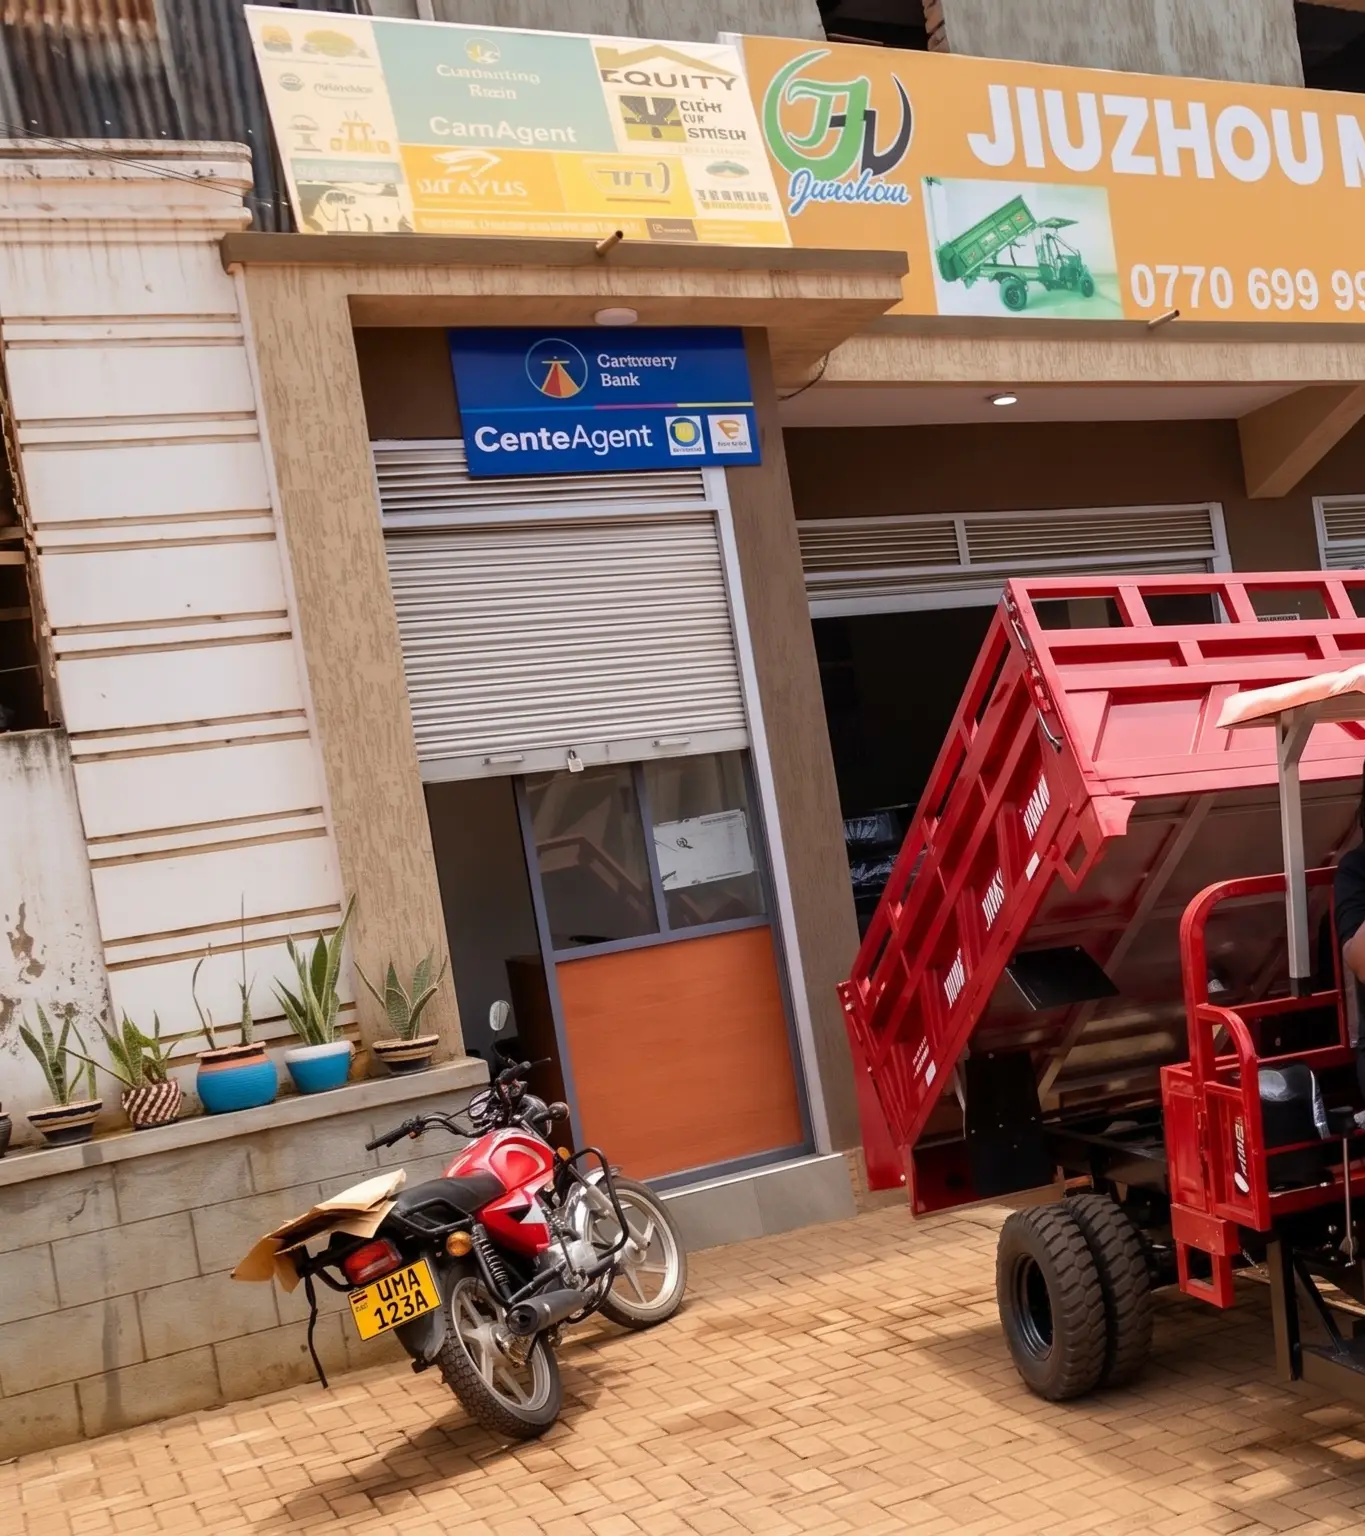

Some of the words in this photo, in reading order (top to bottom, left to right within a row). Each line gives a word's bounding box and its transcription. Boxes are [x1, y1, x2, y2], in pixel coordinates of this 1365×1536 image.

[601, 69, 737, 91] EQUITY
[967, 84, 1324, 186] JIUZHOU
[1131, 264, 1233, 310] 0770
[1248, 268, 1319, 311] 699
[600, 372, 641, 387] Bank
[474, 424, 653, 455] CenteAgent
[376, 1268, 421, 1302] UMA
[374, 1289, 429, 1330] 123A
